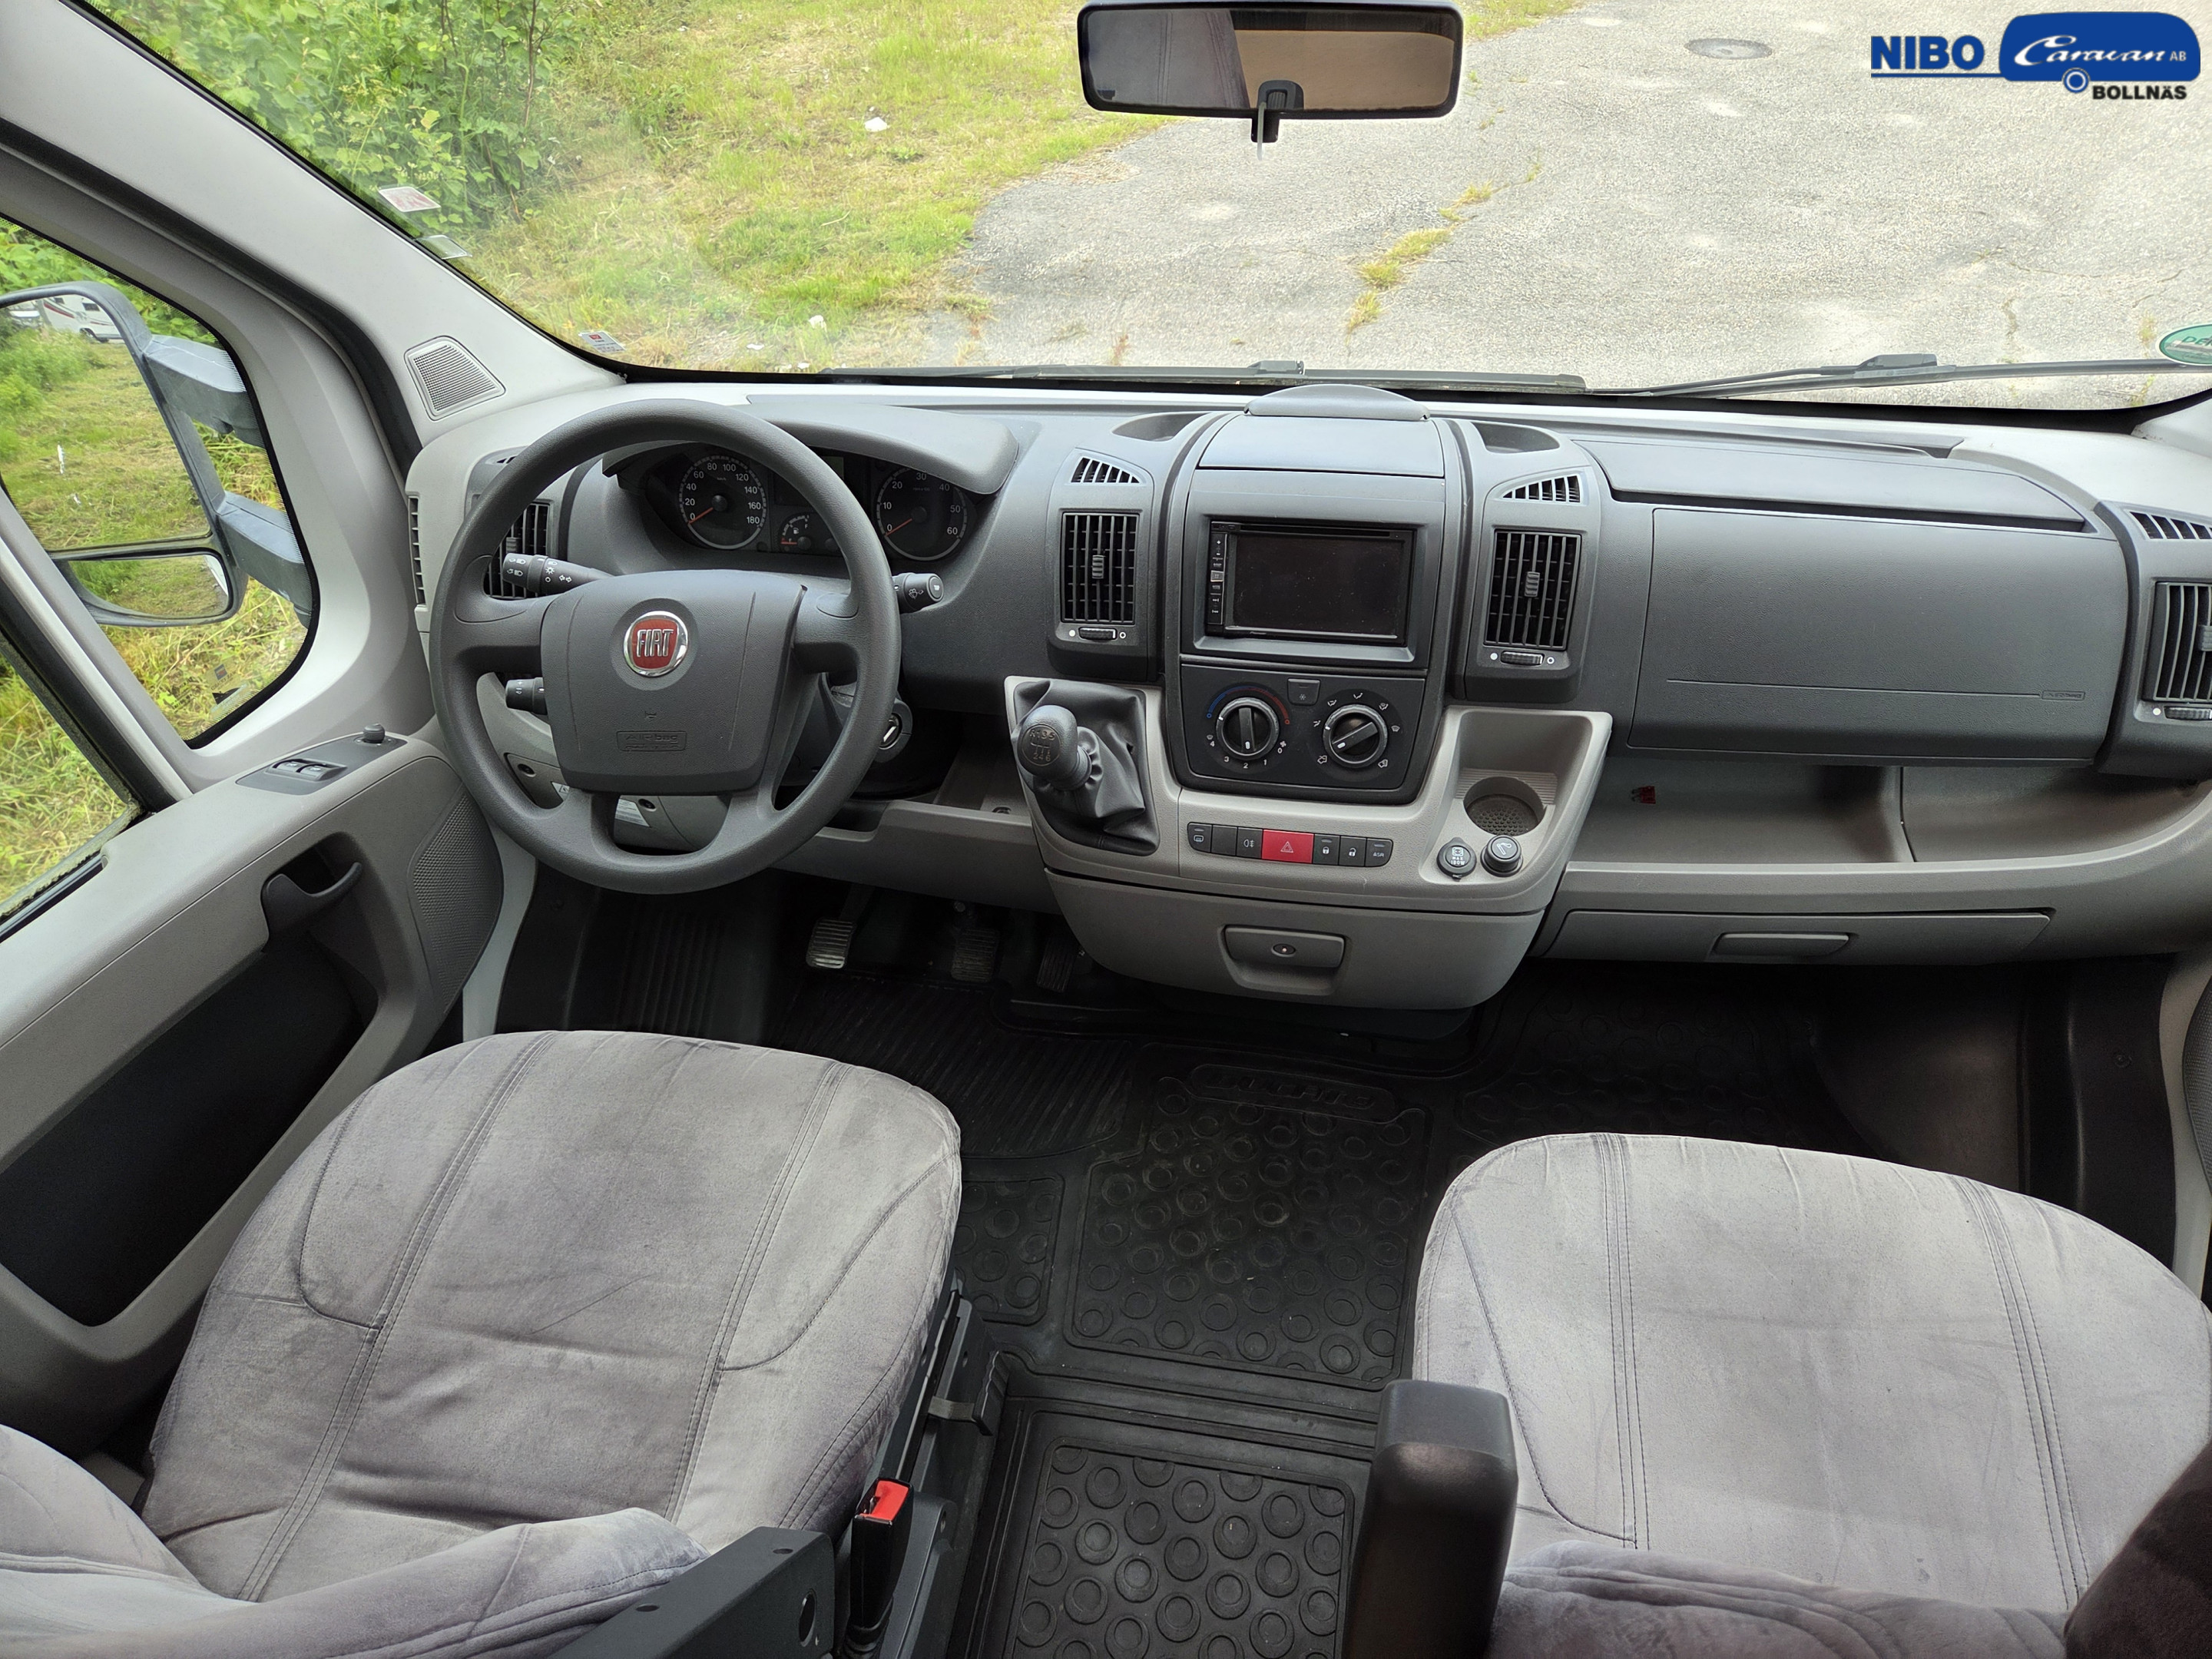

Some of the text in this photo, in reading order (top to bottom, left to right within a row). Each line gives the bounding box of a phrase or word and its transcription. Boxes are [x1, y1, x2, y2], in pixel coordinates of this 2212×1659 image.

[707, 462, 717, 471] 80
[723, 463, 737, 472] 100
[736, 473, 749, 482] 120
[916, 472, 927, 481] 30
[686, 482, 697, 491] 40
[892, 481, 902, 489] 20
[939, 483, 950, 492] 40
[744, 486, 758, 495] 140
[684, 498, 695, 506] 20
[748, 502, 761, 510] 160
[882, 502, 892, 510] 10
[949, 505, 961, 513] 50
[747, 516, 760, 525] 180
[946, 527, 958, 535] 60
[636, 628, 674, 657] FIAT
